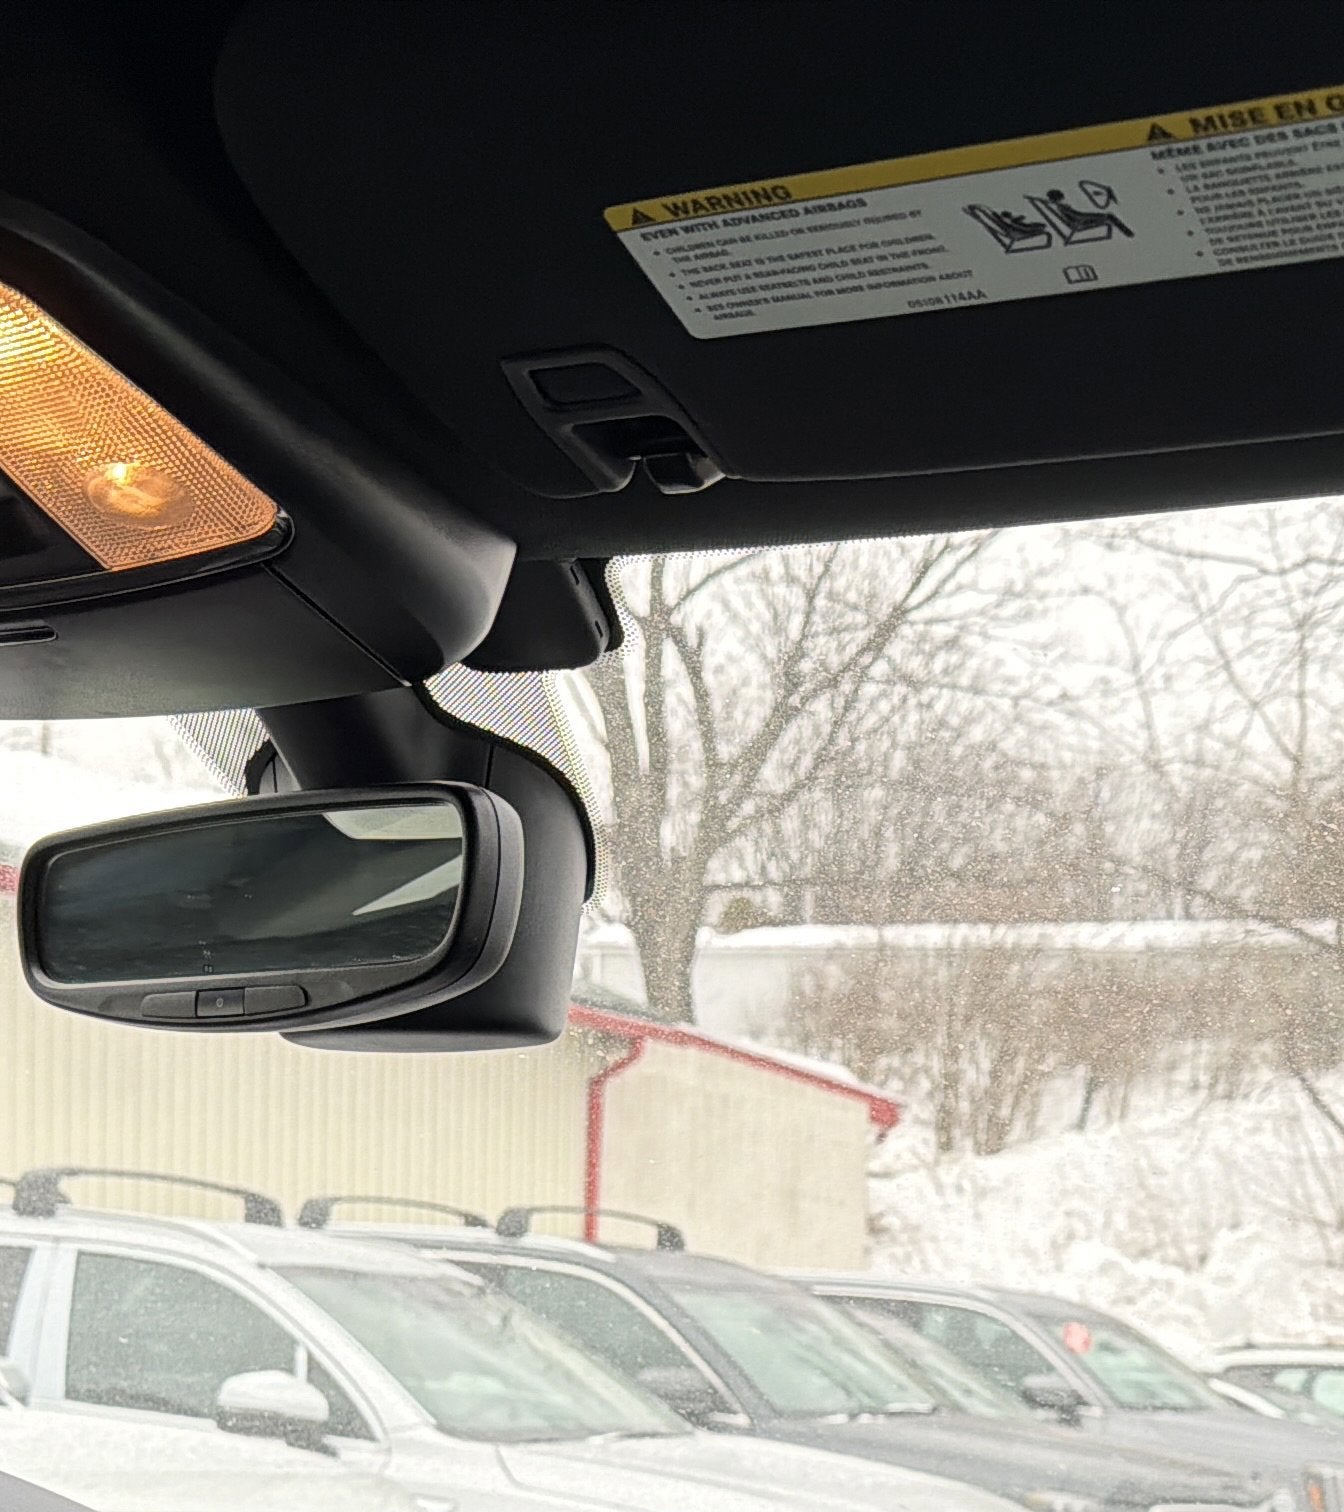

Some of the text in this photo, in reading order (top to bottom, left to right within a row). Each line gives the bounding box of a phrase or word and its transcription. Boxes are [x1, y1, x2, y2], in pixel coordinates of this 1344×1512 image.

[1187, 106, 1267, 133] MISE
[1272, 97, 1318, 119] EN
[638, 196, 868, 242] EVEN WITH ADVANCED AIRBAGS
[662, 185, 793, 218] WARNING
